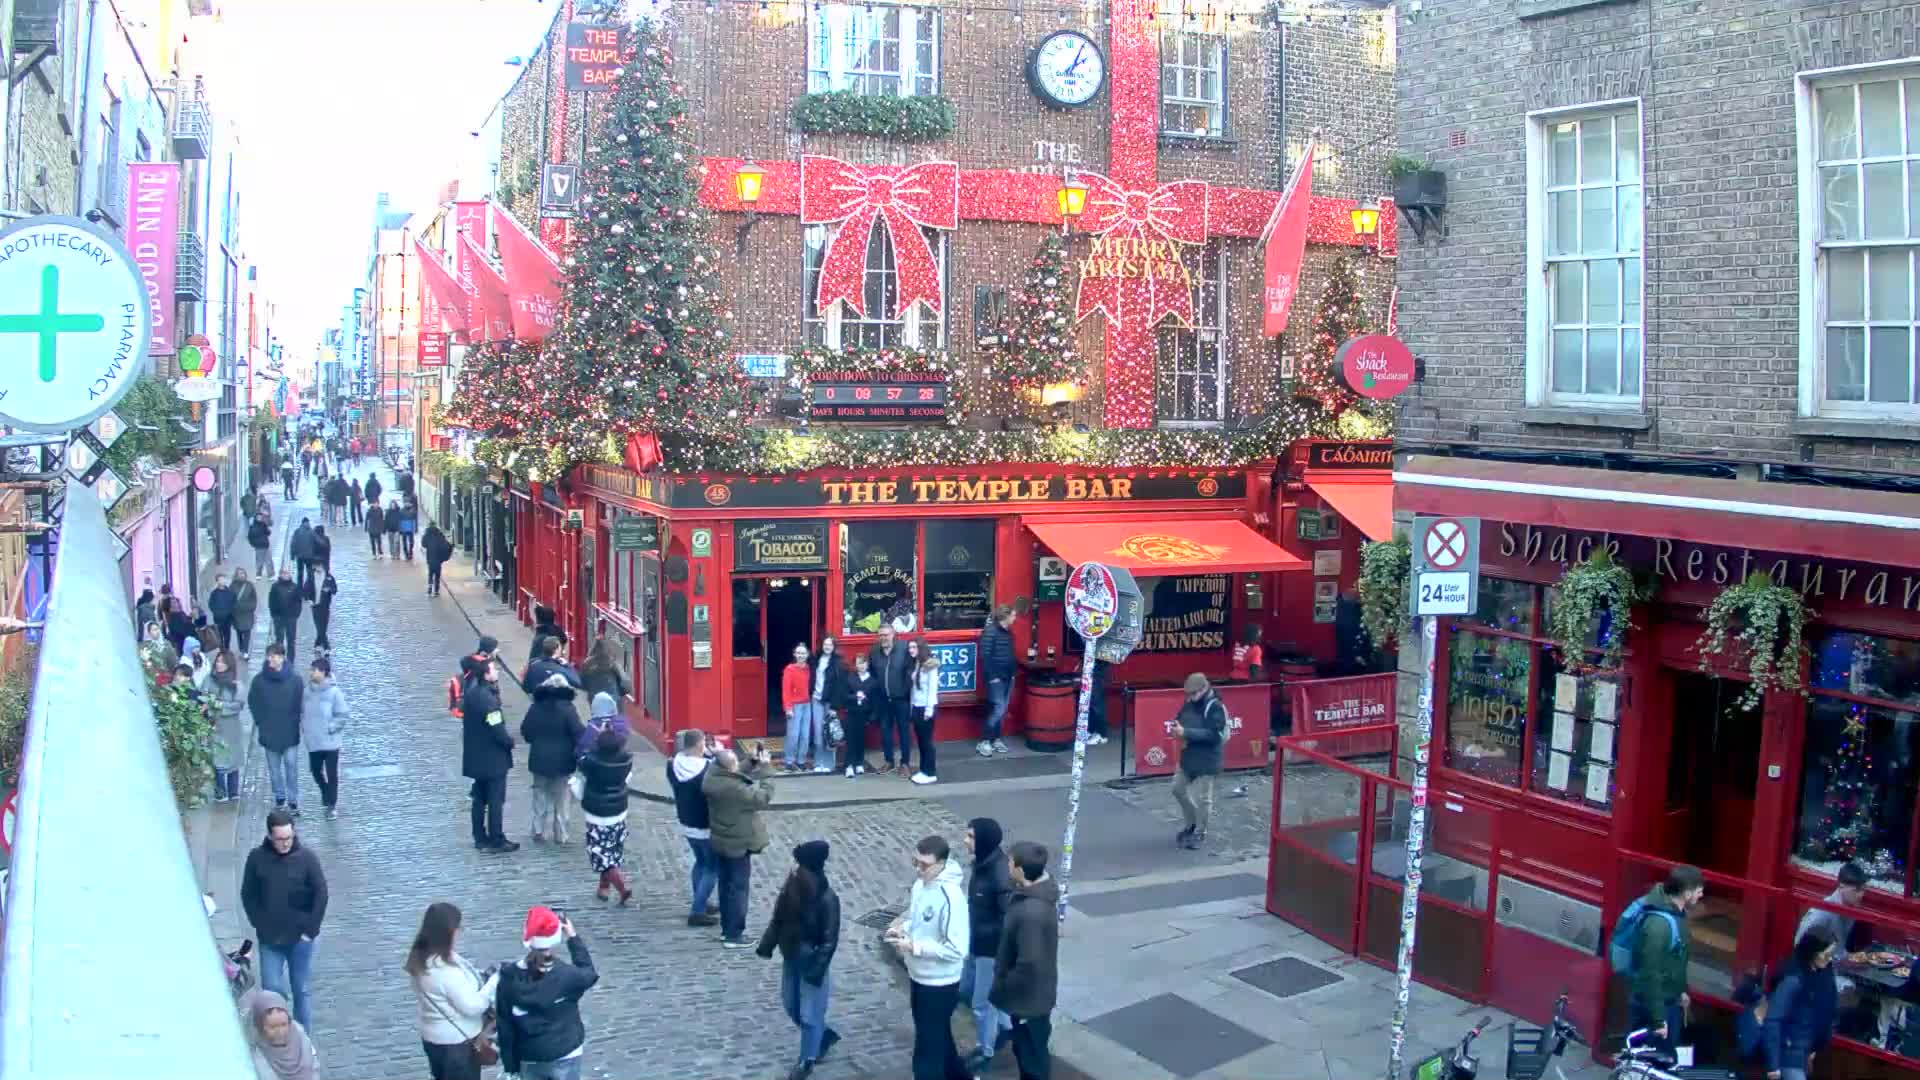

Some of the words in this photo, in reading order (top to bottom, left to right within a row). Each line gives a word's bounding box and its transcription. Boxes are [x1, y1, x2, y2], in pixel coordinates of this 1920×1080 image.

[585, 29, 617, 45] THE
[1032, 140, 1082, 163] THE
[136, 171, 170, 233] NINE
[0, 232, 113, 266] APOTHECARY
[1089, 237, 1185, 264] MERRY
[88, 303, 135, 400] PHARMACY
[1356, 349, 1388, 373] Shack
[811, 371, 873, 382] COUNTDOWN
[890, 371, 945, 382] CHRISTMAS
[826, 387, 835, 400] 0
[887, 387, 903, 400] 57
[812, 407, 833, 416] DAYS
[837, 407, 865, 416] HOURS
[869, 407, 905, 416] MINUTES
[909, 407, 945, 416] SECONDS
[635, 479, 652, 499] BAR
[823, 482, 898, 504] THE
[912, 480, 1050, 502] TEMPLE
[1066, 478, 1132, 499] BAR
[749, 538, 816, 561] TOBACCO
[1500, 521, 1621, 569] Shack
[847, 565, 891, 588] TEMPLE
[1176, 578, 1226, 593] EMPEROR
[1211, 593, 1225, 607] OF
[1422, 584, 1443, 603] 24
[1444, 594, 1465, 602] HOUR
[1314, 707, 1360, 721] TEMPLE
[1362, 703, 1385, 716] BAR
